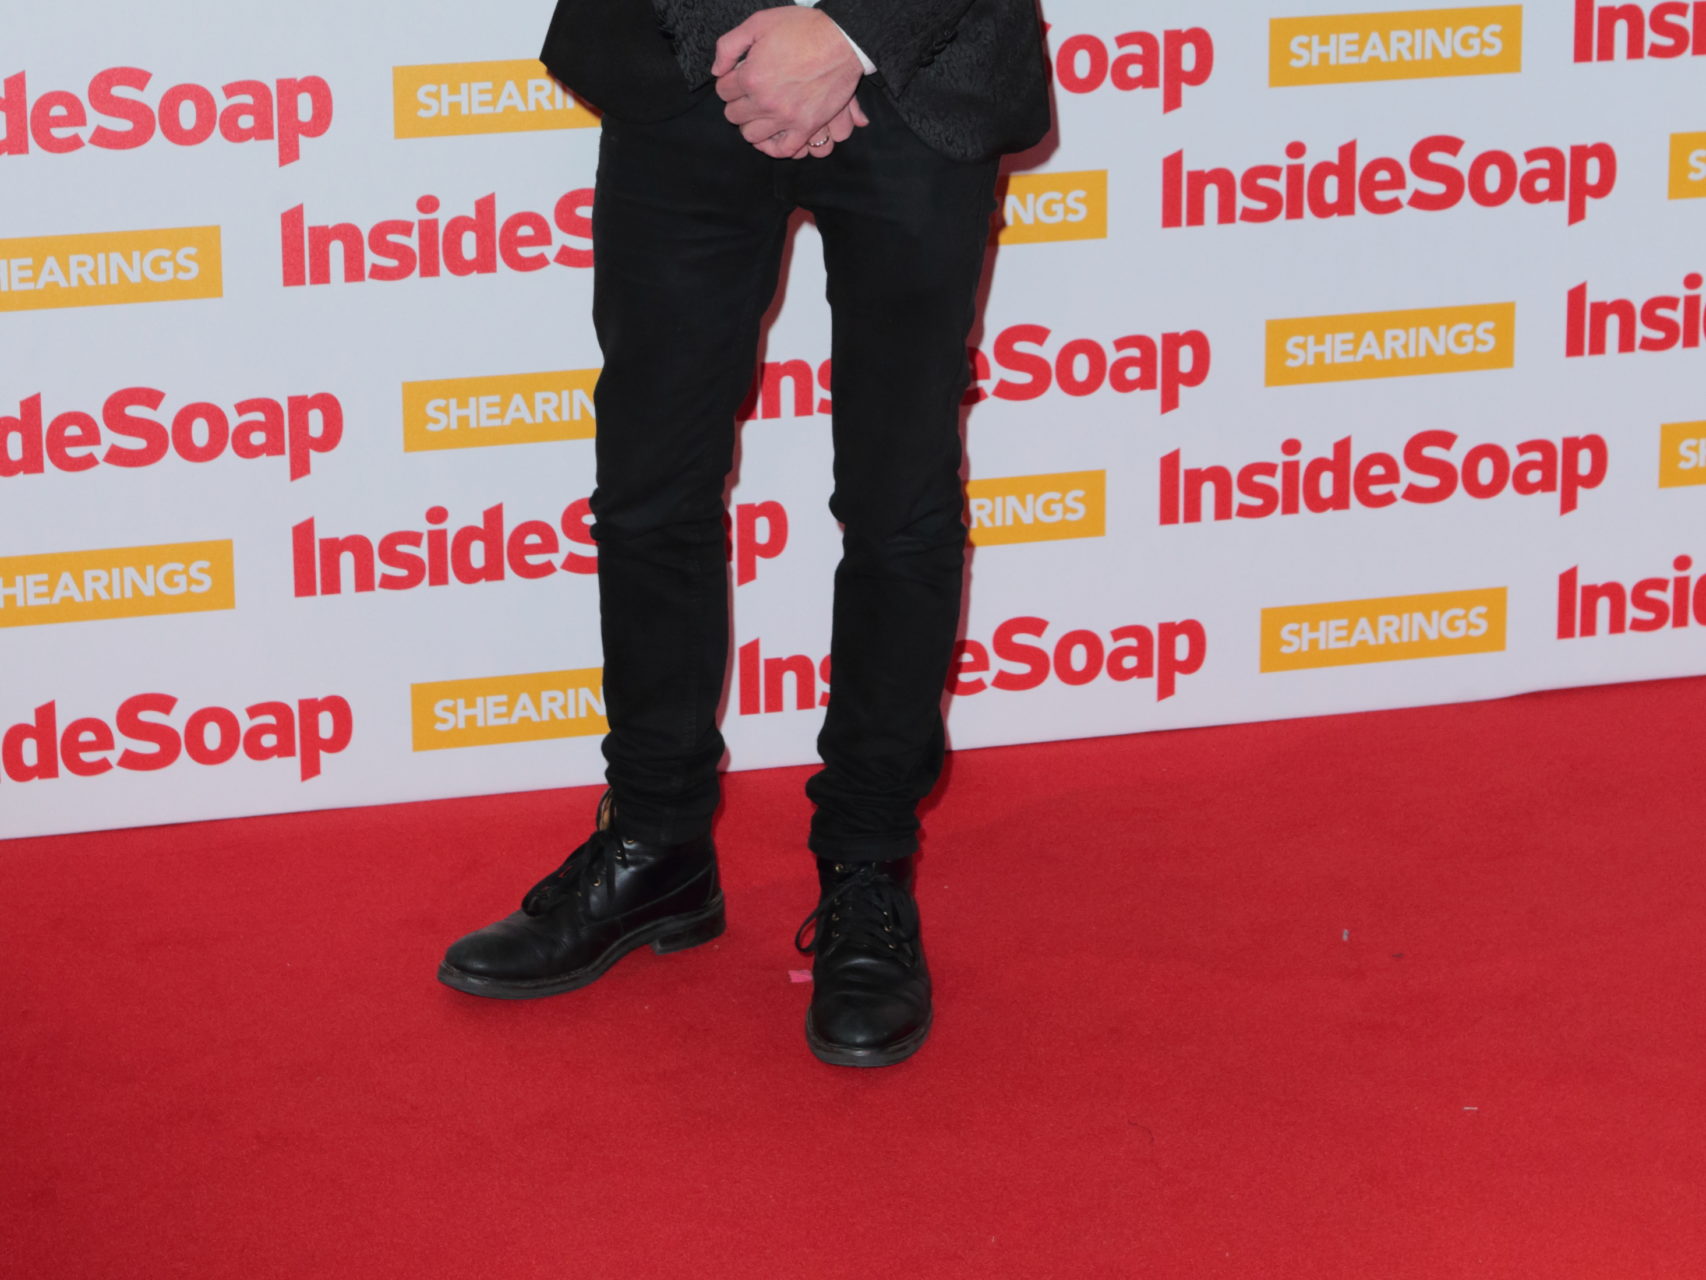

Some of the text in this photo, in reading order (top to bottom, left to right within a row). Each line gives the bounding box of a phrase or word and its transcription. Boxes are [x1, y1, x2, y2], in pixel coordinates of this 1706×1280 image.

[1290, 24, 1502, 67] SHEARINGS
[417, 79, 575, 118] SHEARI
[1162, 135, 1616, 228] InsideSoap
[281, 188, 594, 286] InsideS
[0, 247, 199, 291] EARINGS
[1286, 322, 1495, 367] SHEARINGS
[426, 389, 596, 431] SHEARIN
[0, 387, 343, 480] deSoap
[1159, 430, 1608, 525] InsideSoap
[970, 490, 1085, 528] RINGS
[0, 561, 211, 608] HEARINGS
[1281, 606, 1487, 653] SHEARINGS
[434, 686, 606, 730] SHEARIN
[2, 693, 353, 782] deSoap
